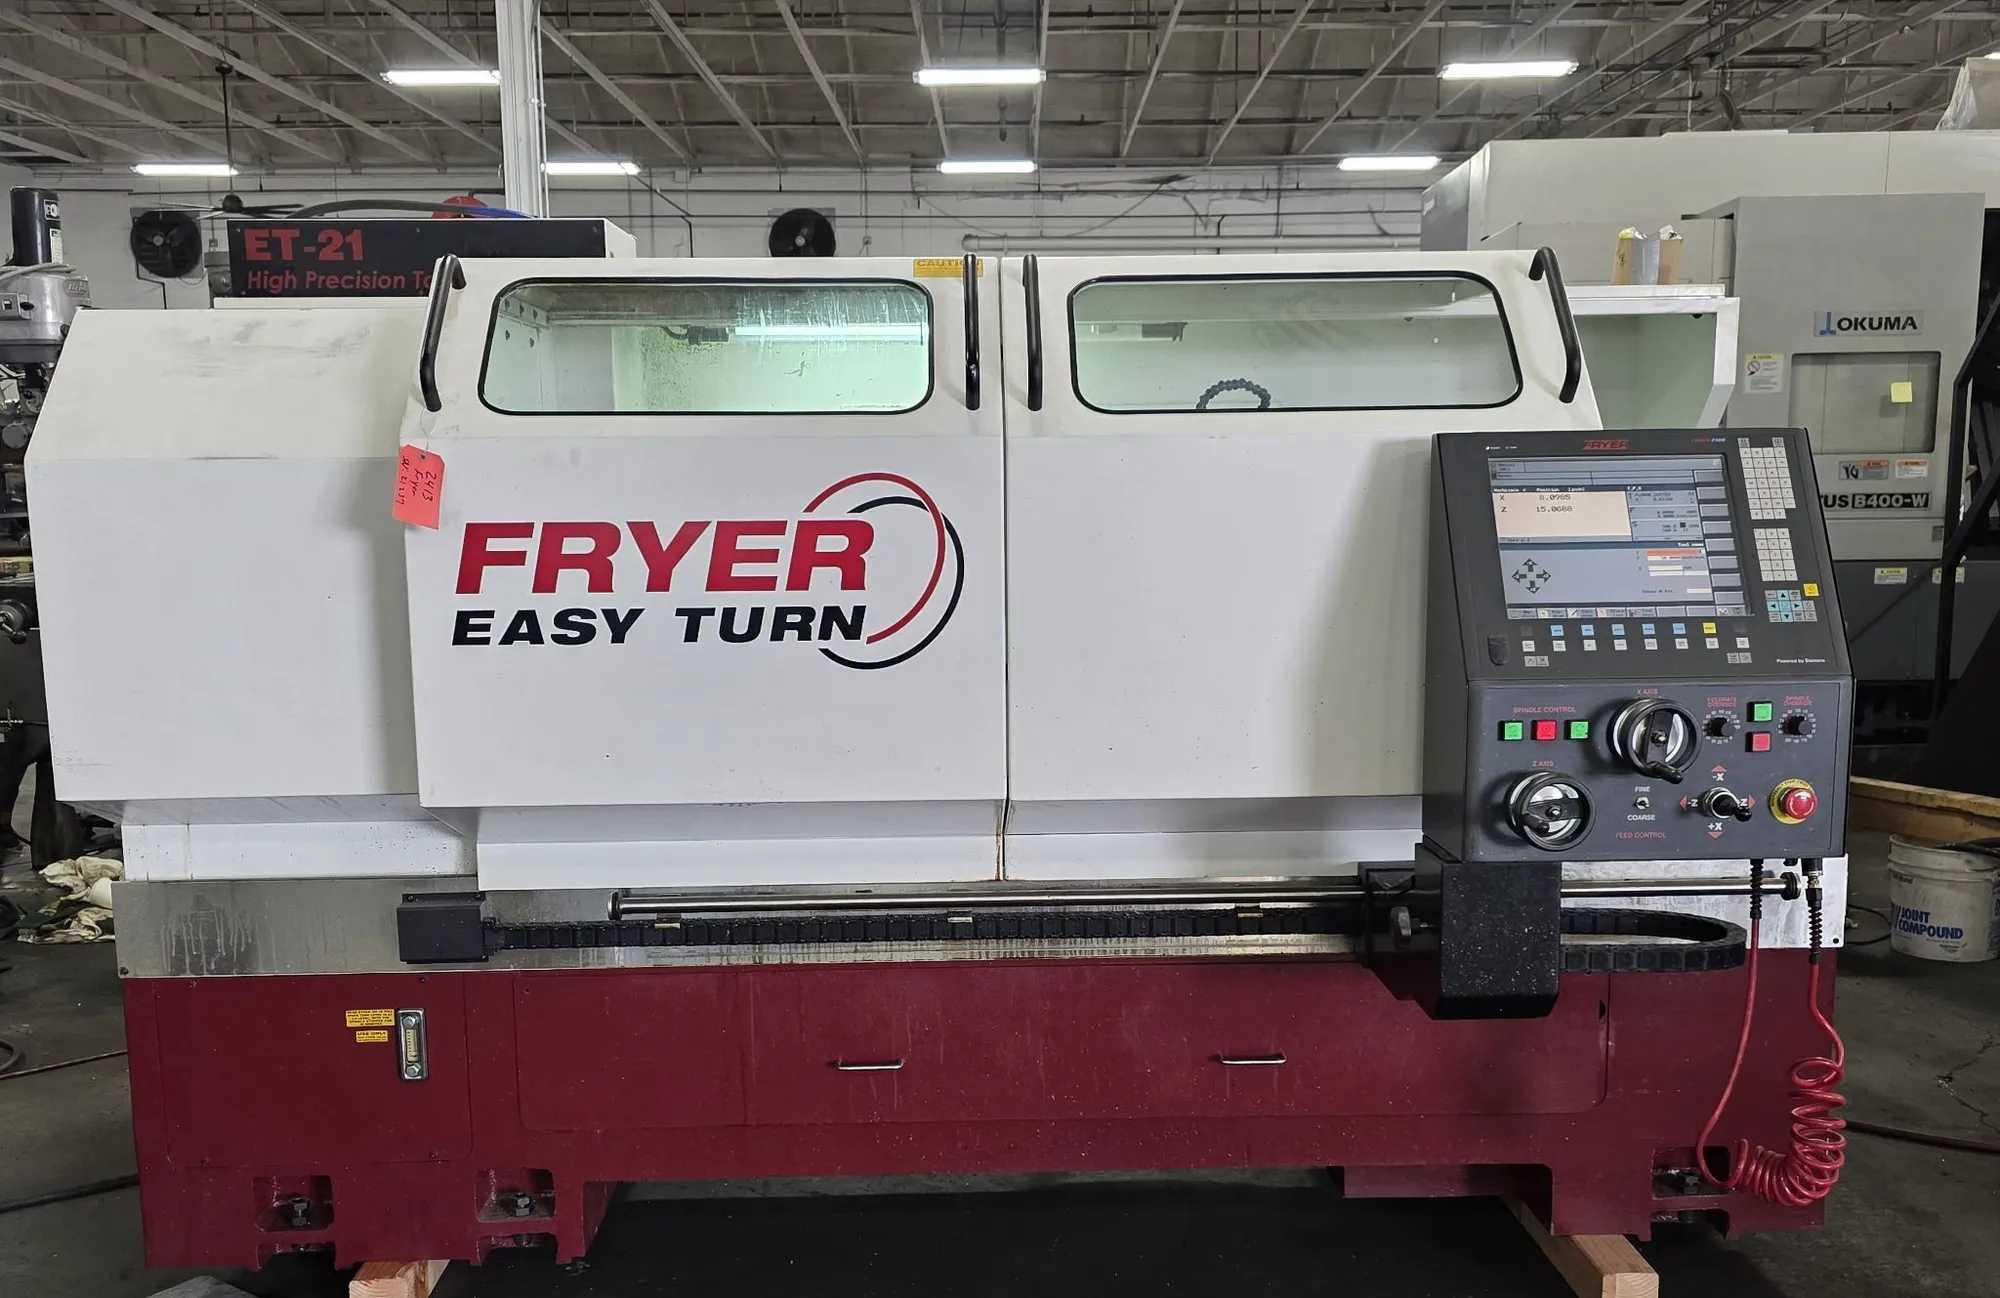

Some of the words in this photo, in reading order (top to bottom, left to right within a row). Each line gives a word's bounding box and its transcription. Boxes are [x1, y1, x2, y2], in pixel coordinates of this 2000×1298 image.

[243, 228, 364, 261] ET-21
[248, 270, 296, 294] High
[305, 270, 405, 289] Precision
[1836, 316, 1918, 331] OKUMA
[1820, 494, 1849, 508] US
[1853, 493, 1928, 508] B400-W
[455, 518, 875, 595] FRYER
[451, 607, 646, 646] EASY
[674, 604, 867, 643] TURN
[1901, 908, 1930, 924] JOINT
[1899, 919, 1963, 939] COMPOUND
